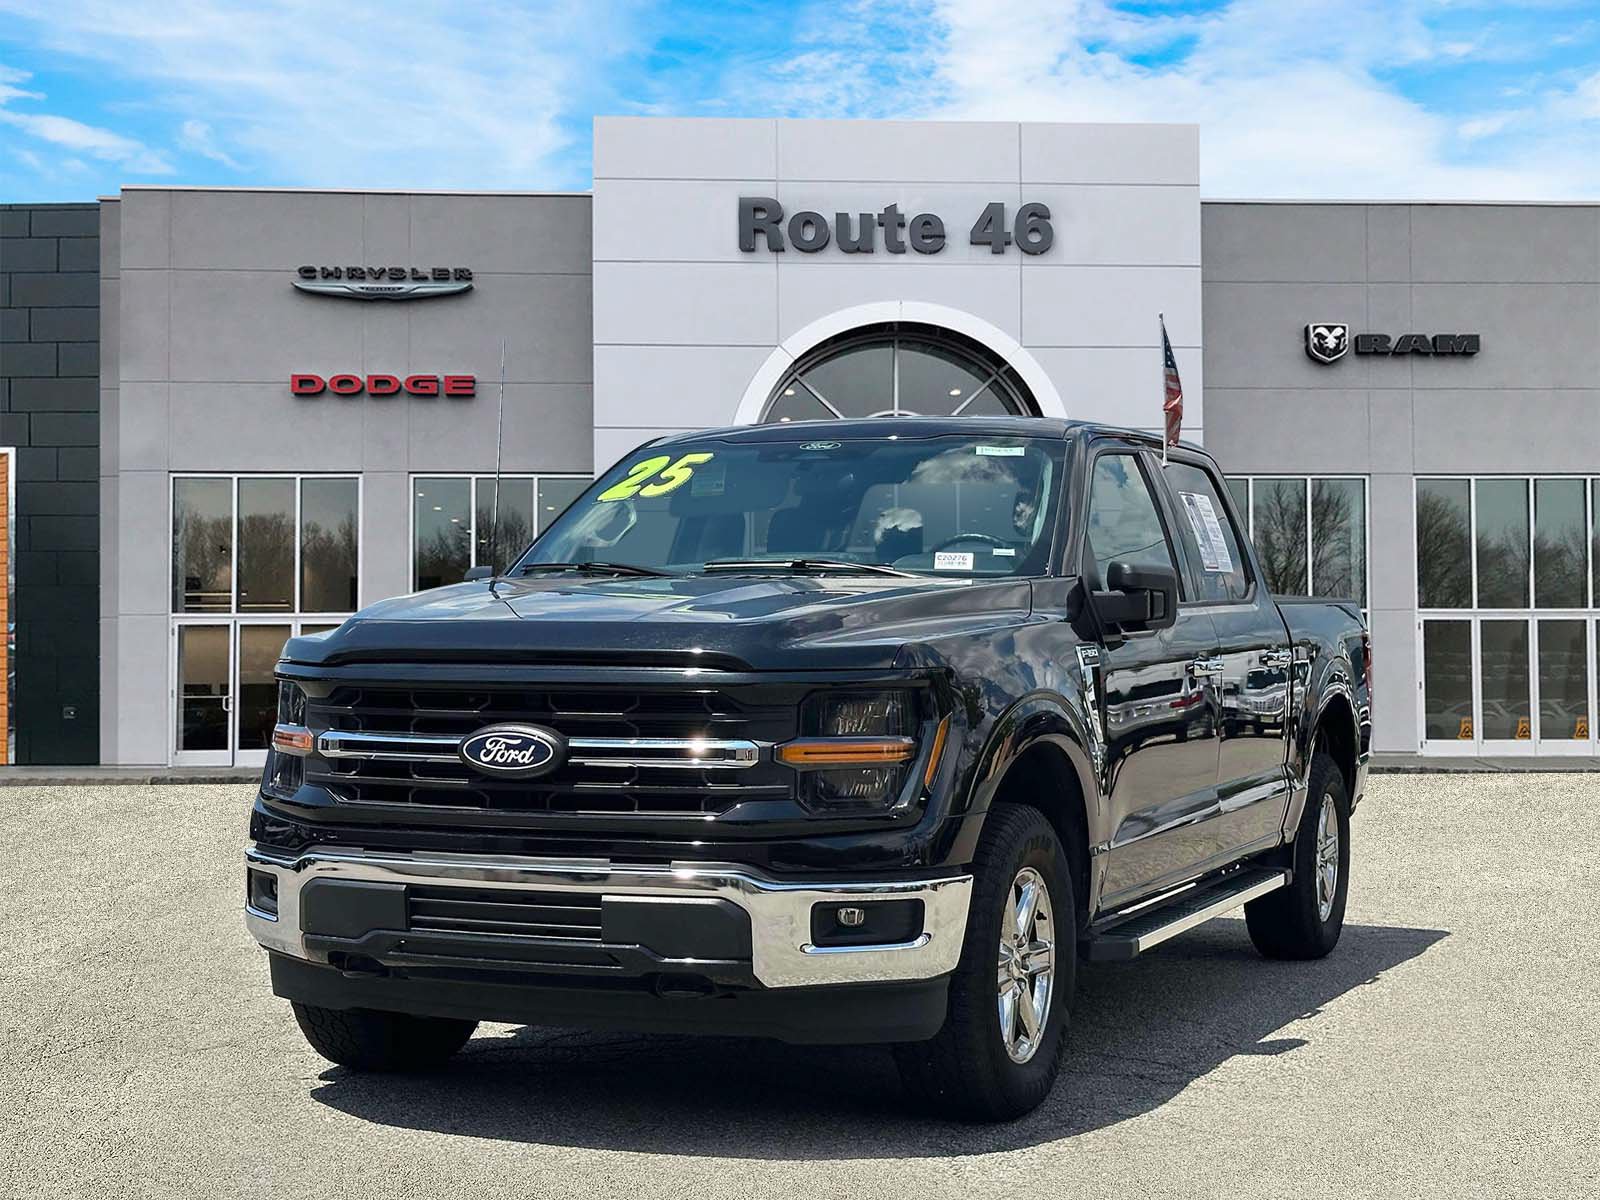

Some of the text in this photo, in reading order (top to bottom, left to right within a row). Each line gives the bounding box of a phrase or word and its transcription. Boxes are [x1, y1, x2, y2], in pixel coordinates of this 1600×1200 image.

[738, 197, 1054, 255] Route 46
[297, 266, 473, 280] CHRYSLER
[1355, 334, 1480, 355] RAM
[290, 374, 476, 396] DODGE
[596, 452, 715, 502] 25
[480, 737, 536, 764] Ford
